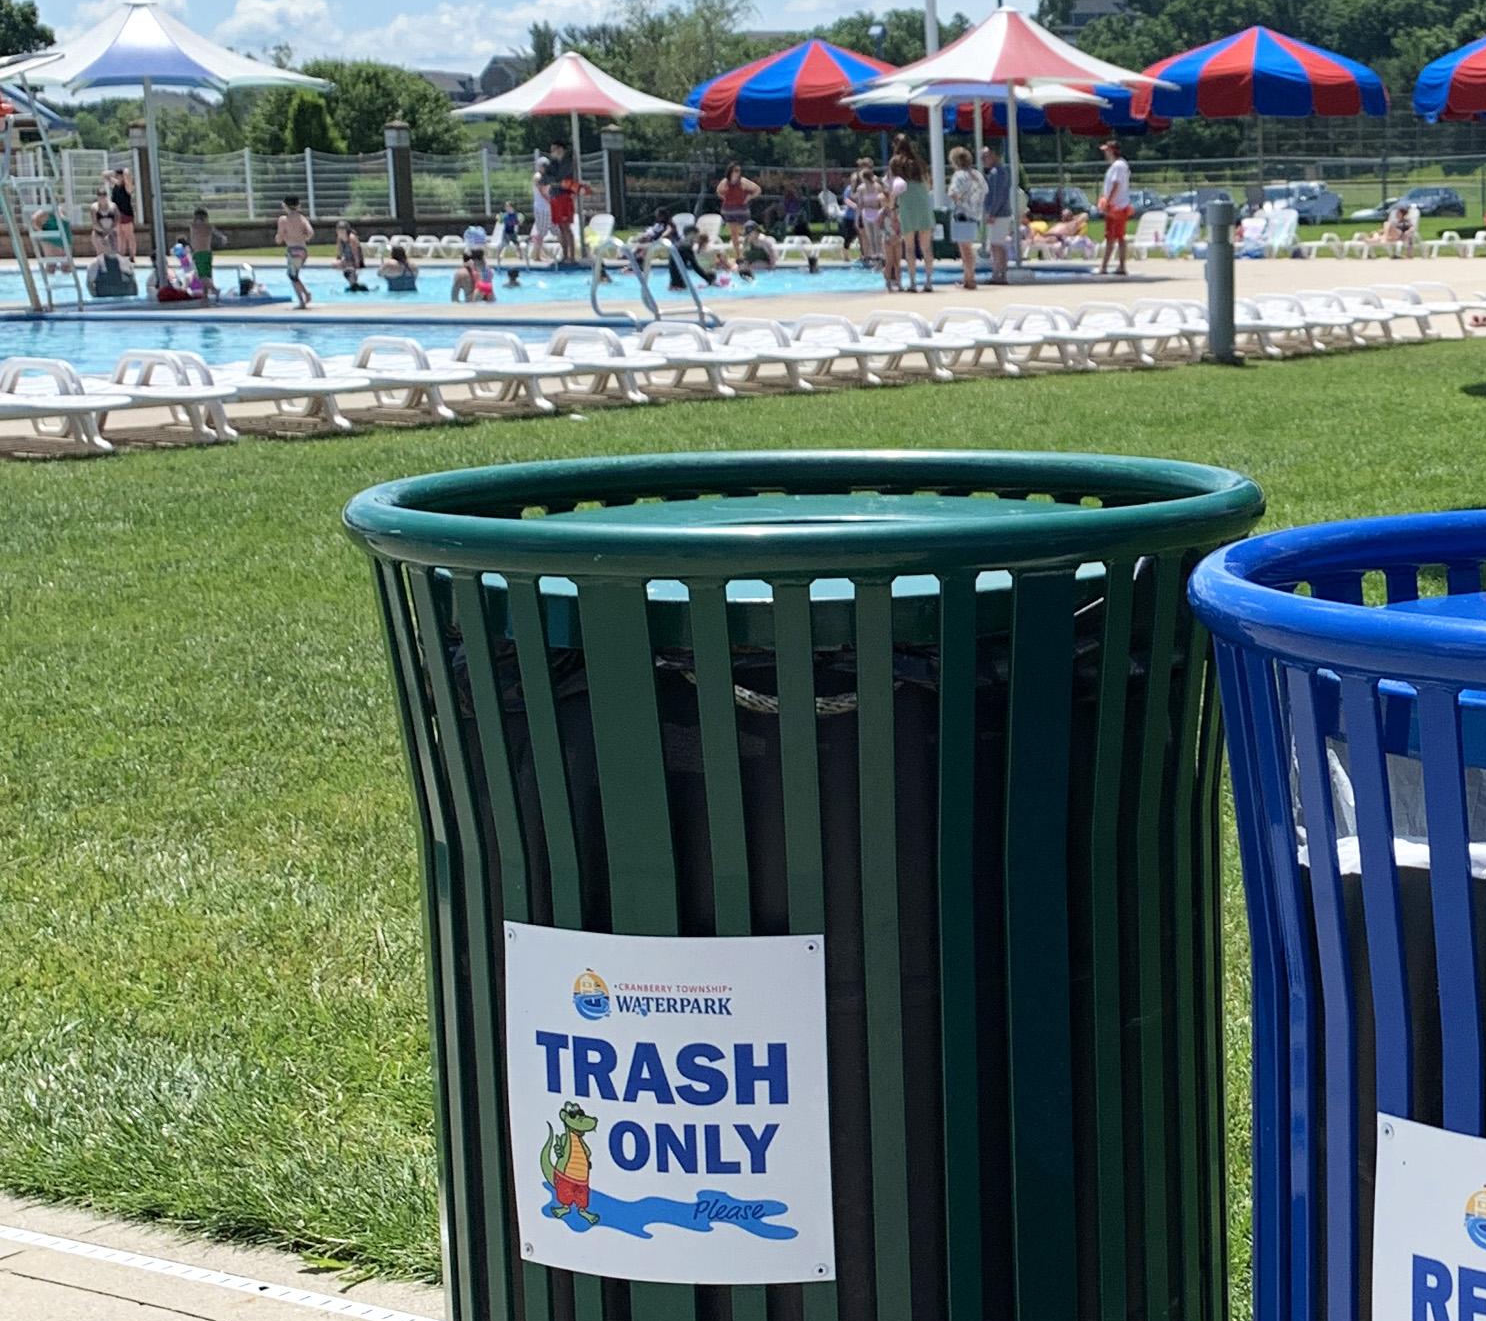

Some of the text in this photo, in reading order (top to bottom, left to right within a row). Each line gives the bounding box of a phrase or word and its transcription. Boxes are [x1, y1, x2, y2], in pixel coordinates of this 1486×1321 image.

[618, 982, 728, 994] CRANBERRY TOWNSHIP
[615, 995, 732, 1016] WATERPARK
[536, 1030, 789, 1106] TRASH
[608, 1120, 780, 1174] ONLY
[693, 1200, 766, 1221] Please
